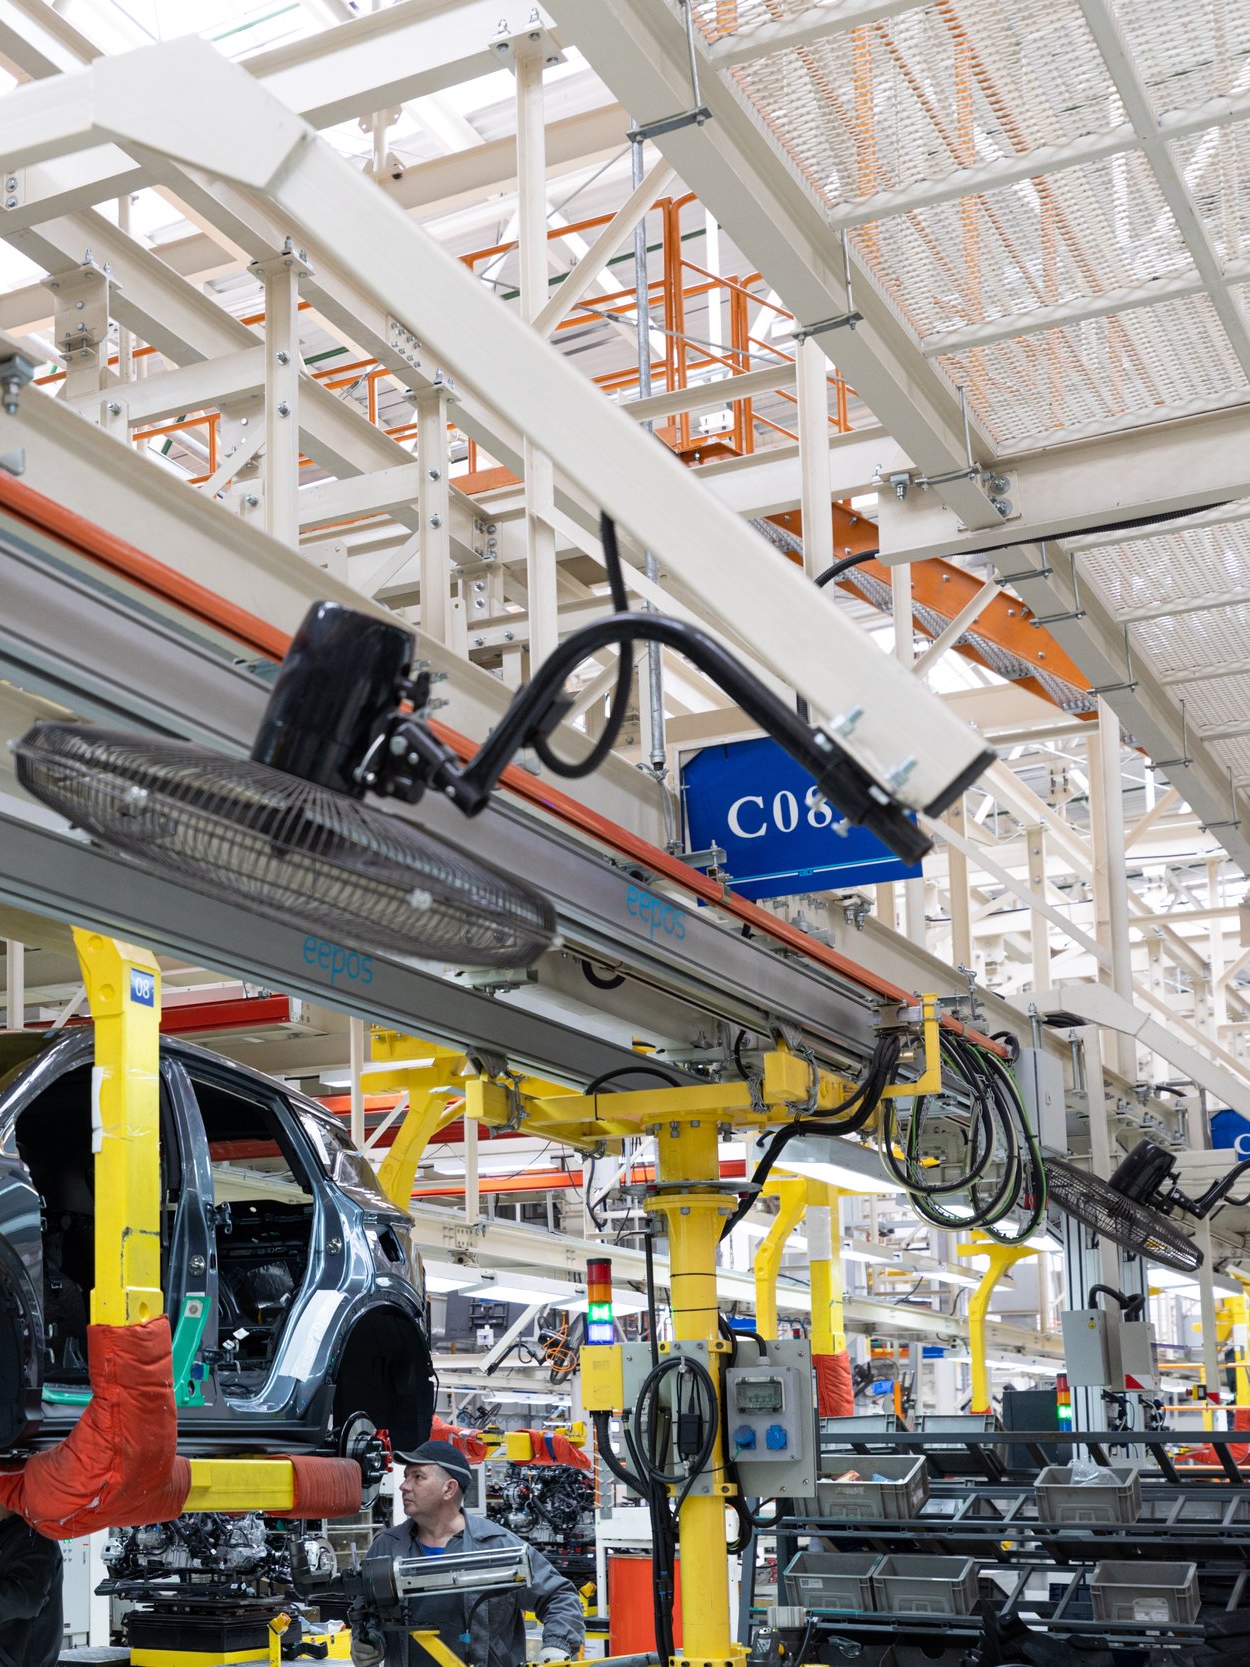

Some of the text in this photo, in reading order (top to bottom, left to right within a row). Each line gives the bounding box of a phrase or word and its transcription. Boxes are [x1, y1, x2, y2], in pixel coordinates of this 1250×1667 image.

[727, 785, 848, 838] C08
[627, 885, 686, 940] eepos
[303, 936, 374, 986] eepos
[135, 977, 150, 999] 08
